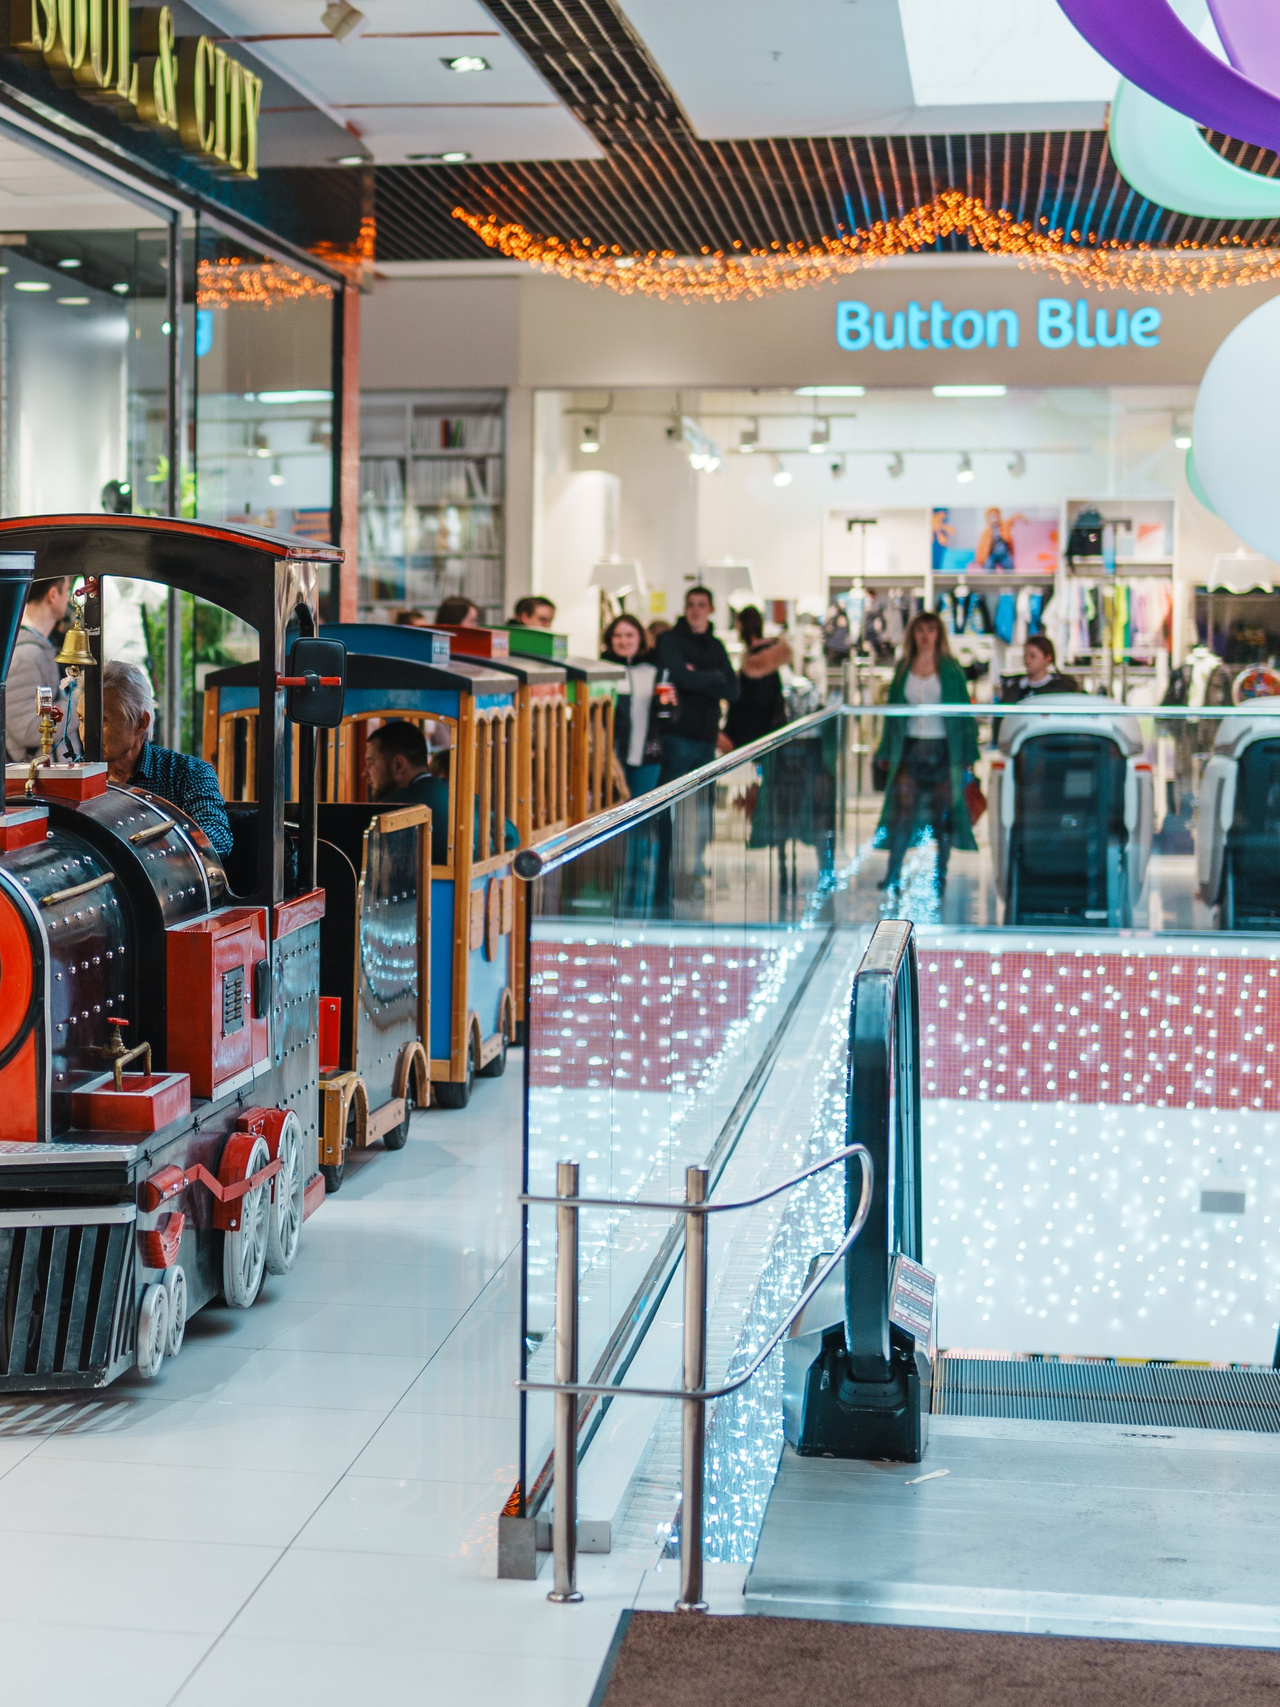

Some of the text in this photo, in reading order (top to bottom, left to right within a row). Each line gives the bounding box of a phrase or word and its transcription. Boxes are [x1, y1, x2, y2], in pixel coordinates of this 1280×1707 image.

[153, 5, 178, 130] &
[195, 35, 262, 180] CITY
[836, 298, 1162, 351] Button Blue
